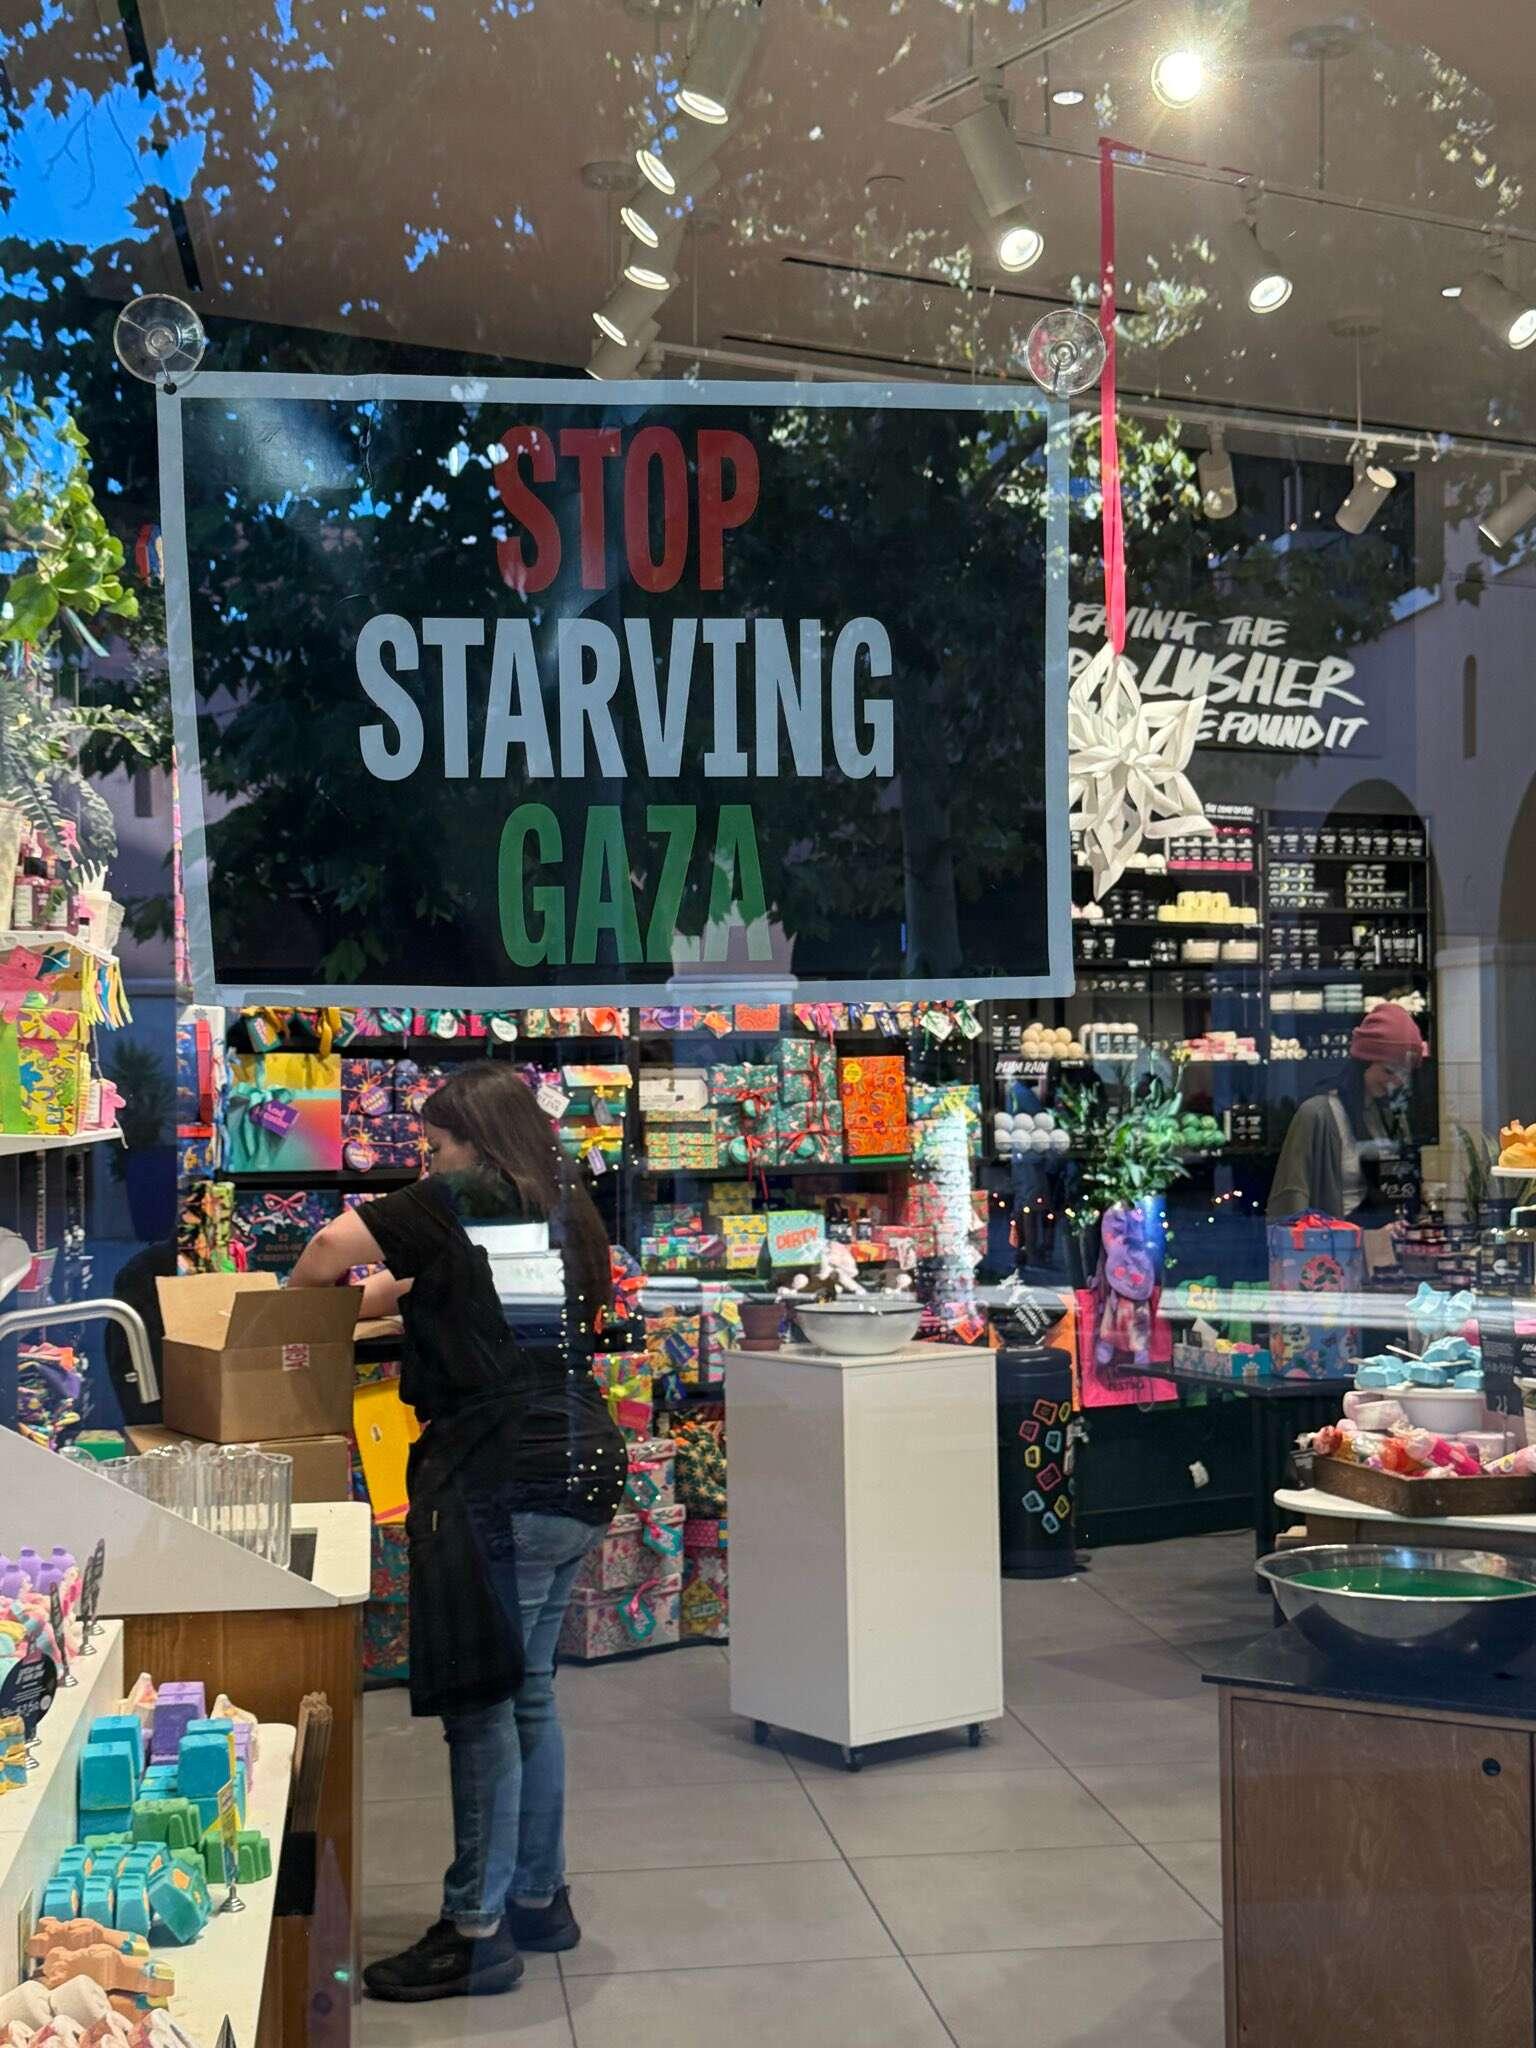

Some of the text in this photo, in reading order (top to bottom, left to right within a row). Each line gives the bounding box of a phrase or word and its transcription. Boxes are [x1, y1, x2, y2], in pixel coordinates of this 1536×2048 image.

[494, 425, 760, 593] STOP
[1218, 614, 1290, 647] THE
[355, 614, 895, 781] STARVING
[1139, 644, 1365, 709] LUSHER
[1217, 711, 1325, 749] FOUND
[1324, 716, 1369, 749] IT
[498, 803, 773, 967] GAZA
[776, 1227, 818, 1250] DIRTY
